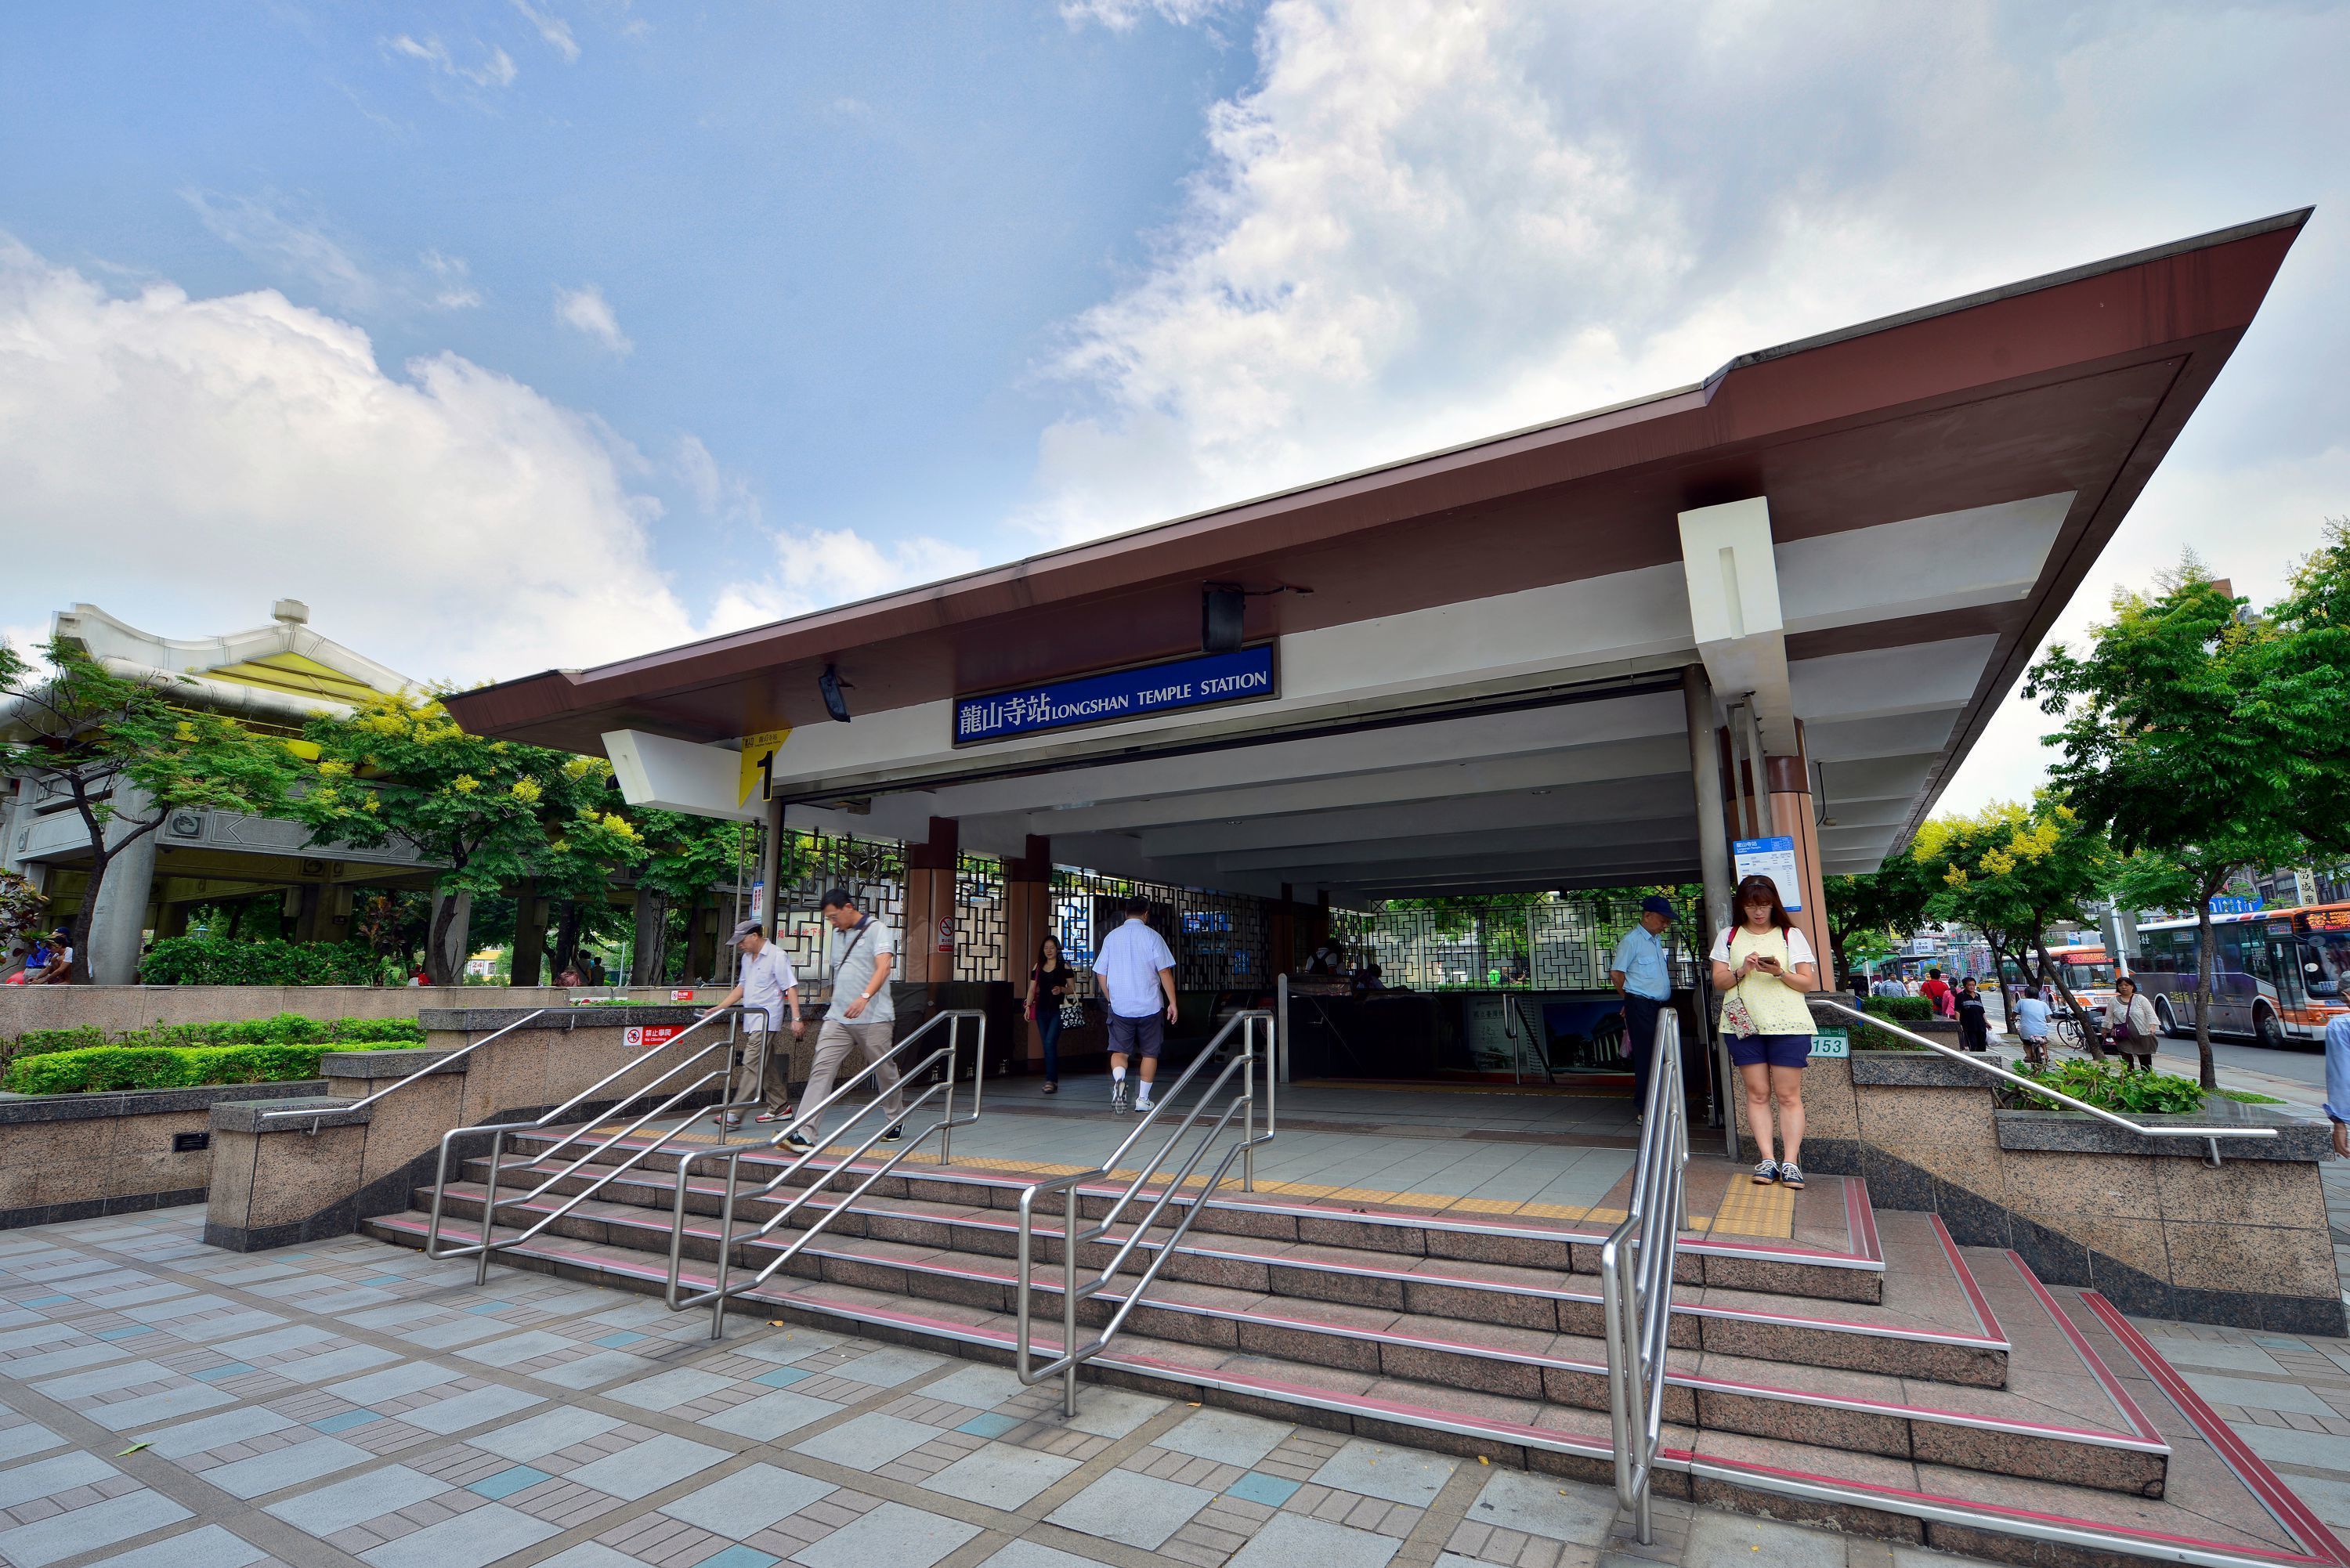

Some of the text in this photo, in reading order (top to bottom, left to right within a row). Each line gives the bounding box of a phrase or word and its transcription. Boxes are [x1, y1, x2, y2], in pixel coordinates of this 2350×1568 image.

[960, 693, 1050, 735] 龍山寺站
[1052, 670, 1267, 721] LONGSHAN TEMPLE STATION
[757, 750, 773, 800] 1
[1813, 1039, 1842, 1053] 153
